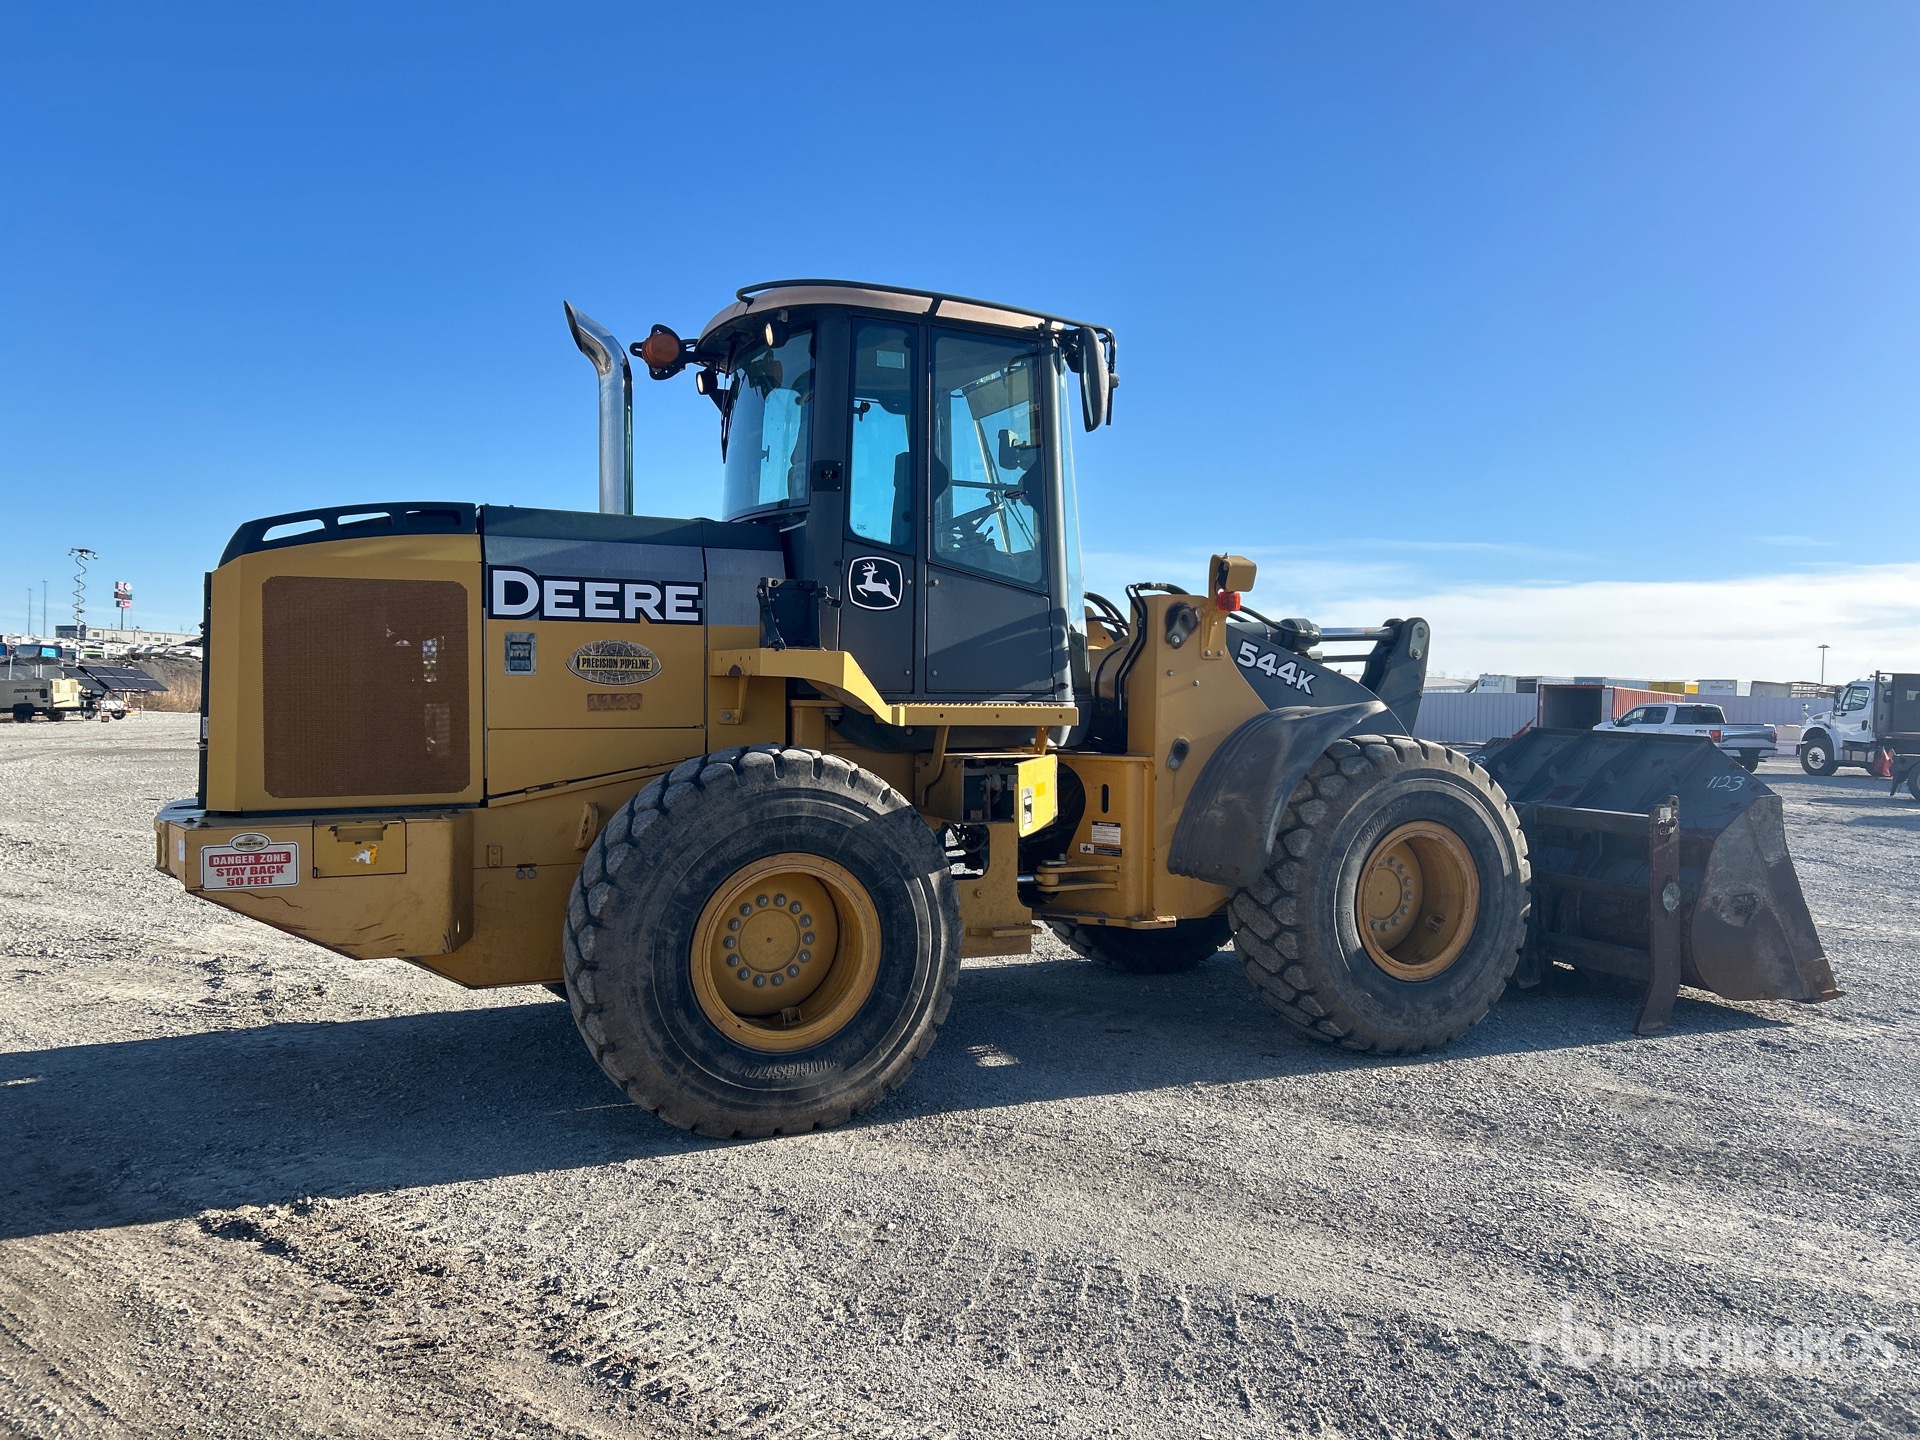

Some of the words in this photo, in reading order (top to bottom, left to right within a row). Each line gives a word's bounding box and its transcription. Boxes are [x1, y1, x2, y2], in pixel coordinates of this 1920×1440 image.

[492, 569, 699, 622] DEERE
[581, 657, 618, 669] PRECISION
[620, 658, 650, 670] PIPELINE
[1237, 642, 1316, 695] 544K
[1706, 775, 1746, 792] 1123
[213, 855, 255, 865] DANGER
[260, 853, 286, 863] ZONE
[216, 867, 246, 877] STAY
[250, 865, 284, 875] BACK
[227, 877, 244, 886] 50
[247, 875, 274, 885] FEET
